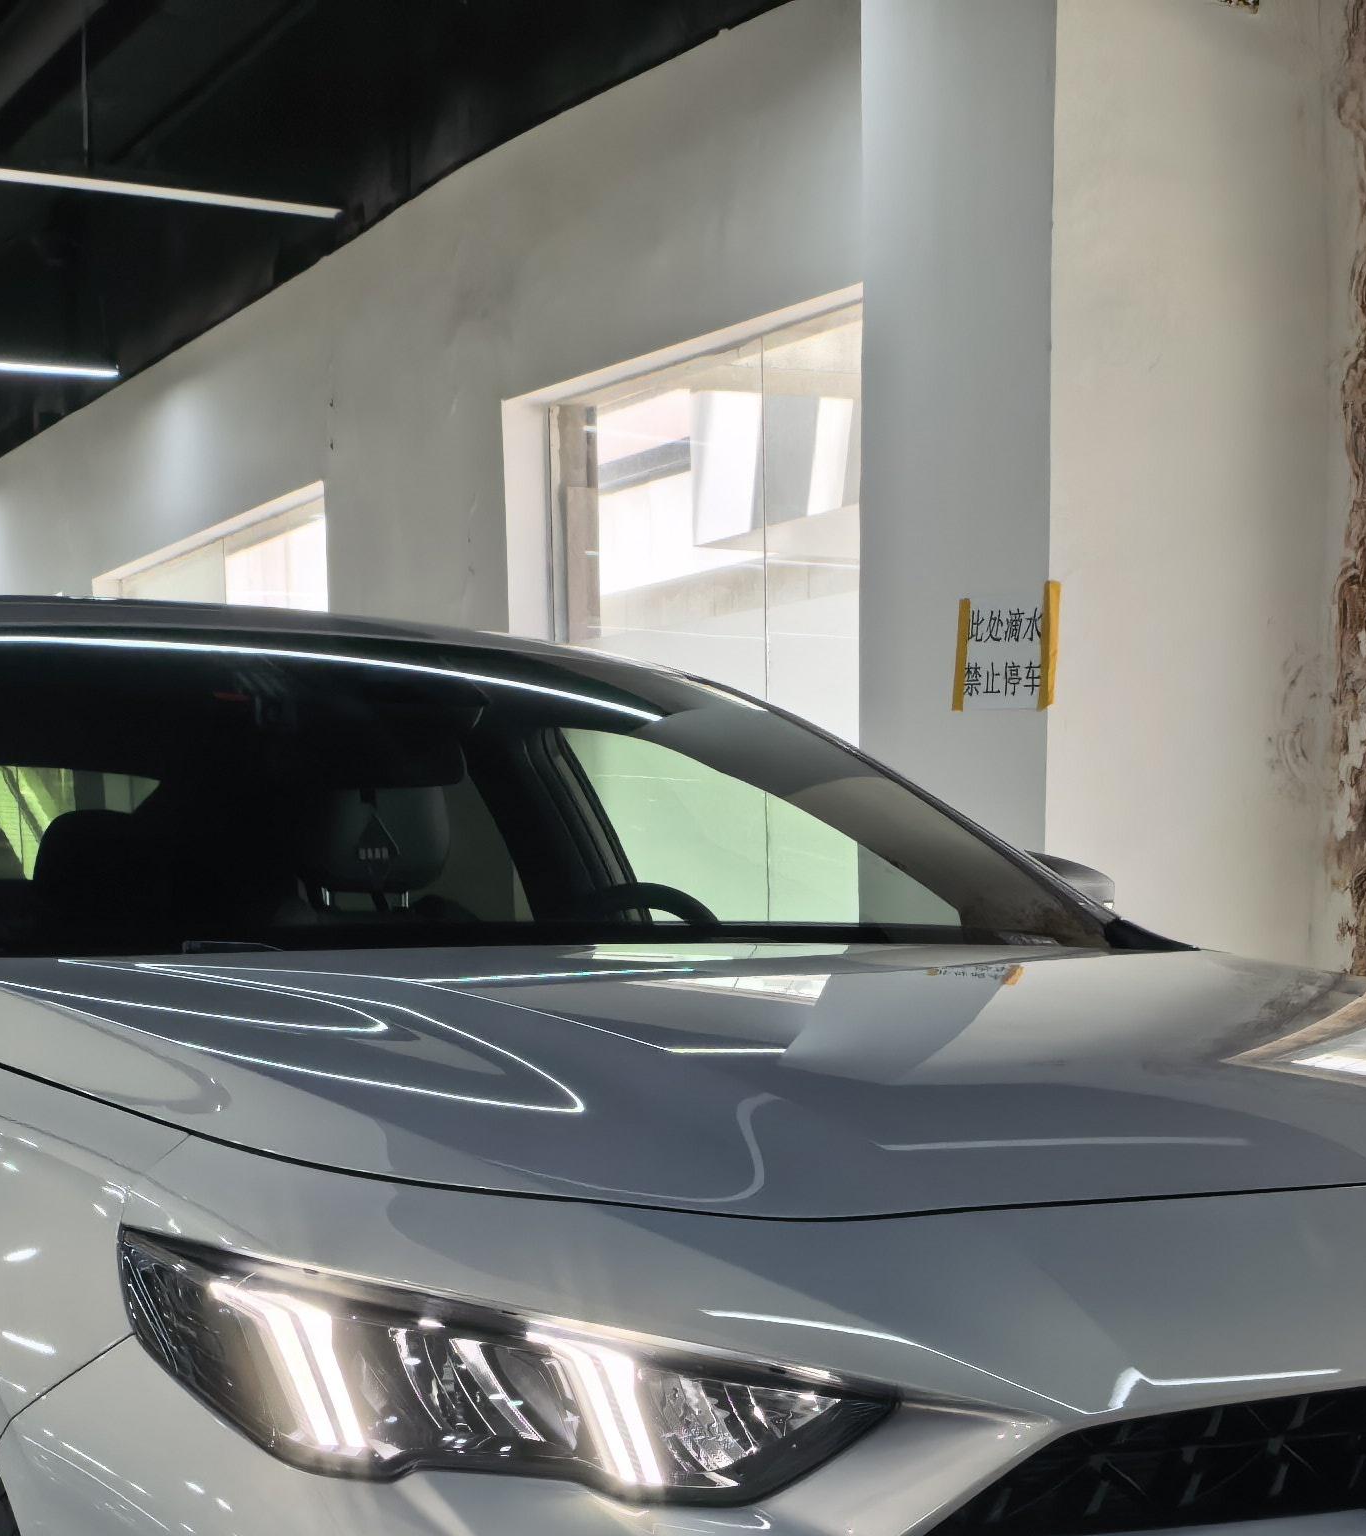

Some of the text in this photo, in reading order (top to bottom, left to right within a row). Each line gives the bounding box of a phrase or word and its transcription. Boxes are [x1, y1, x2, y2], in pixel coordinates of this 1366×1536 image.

[968, 607, 1043, 643] 此处滴水
[963, 660, 1041, 697] 禁止停车
